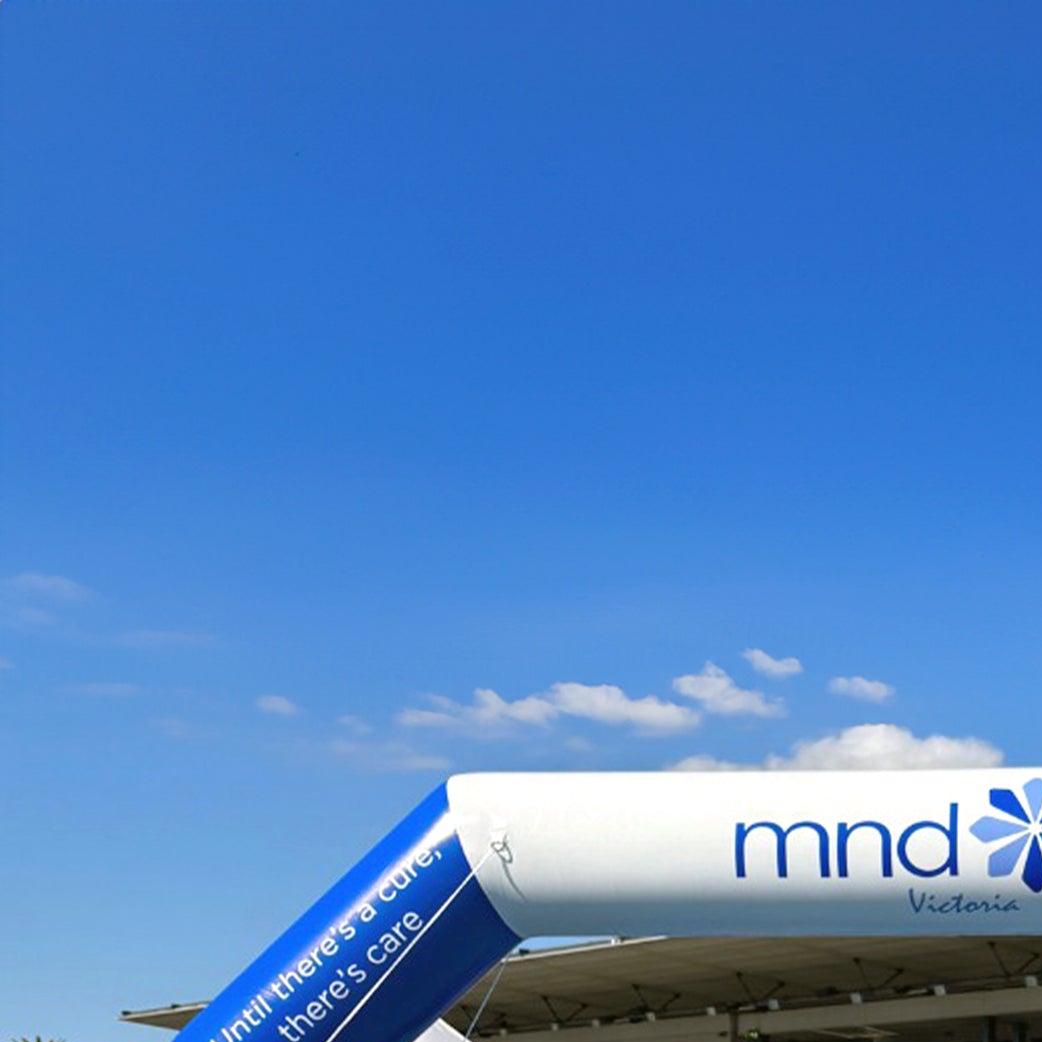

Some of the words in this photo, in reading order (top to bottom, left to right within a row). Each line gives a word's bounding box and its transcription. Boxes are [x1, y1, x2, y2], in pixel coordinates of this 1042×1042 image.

[735, 802, 958, 878] mnd
[271, 927, 356, 1000] there's
[360, 902, 377, 922] a
[377, 849, 442, 902] cure,
[908, 888, 1020, 913] Victoria
[277, 963, 367, 1042] there's
[367, 911, 423, 965] care
